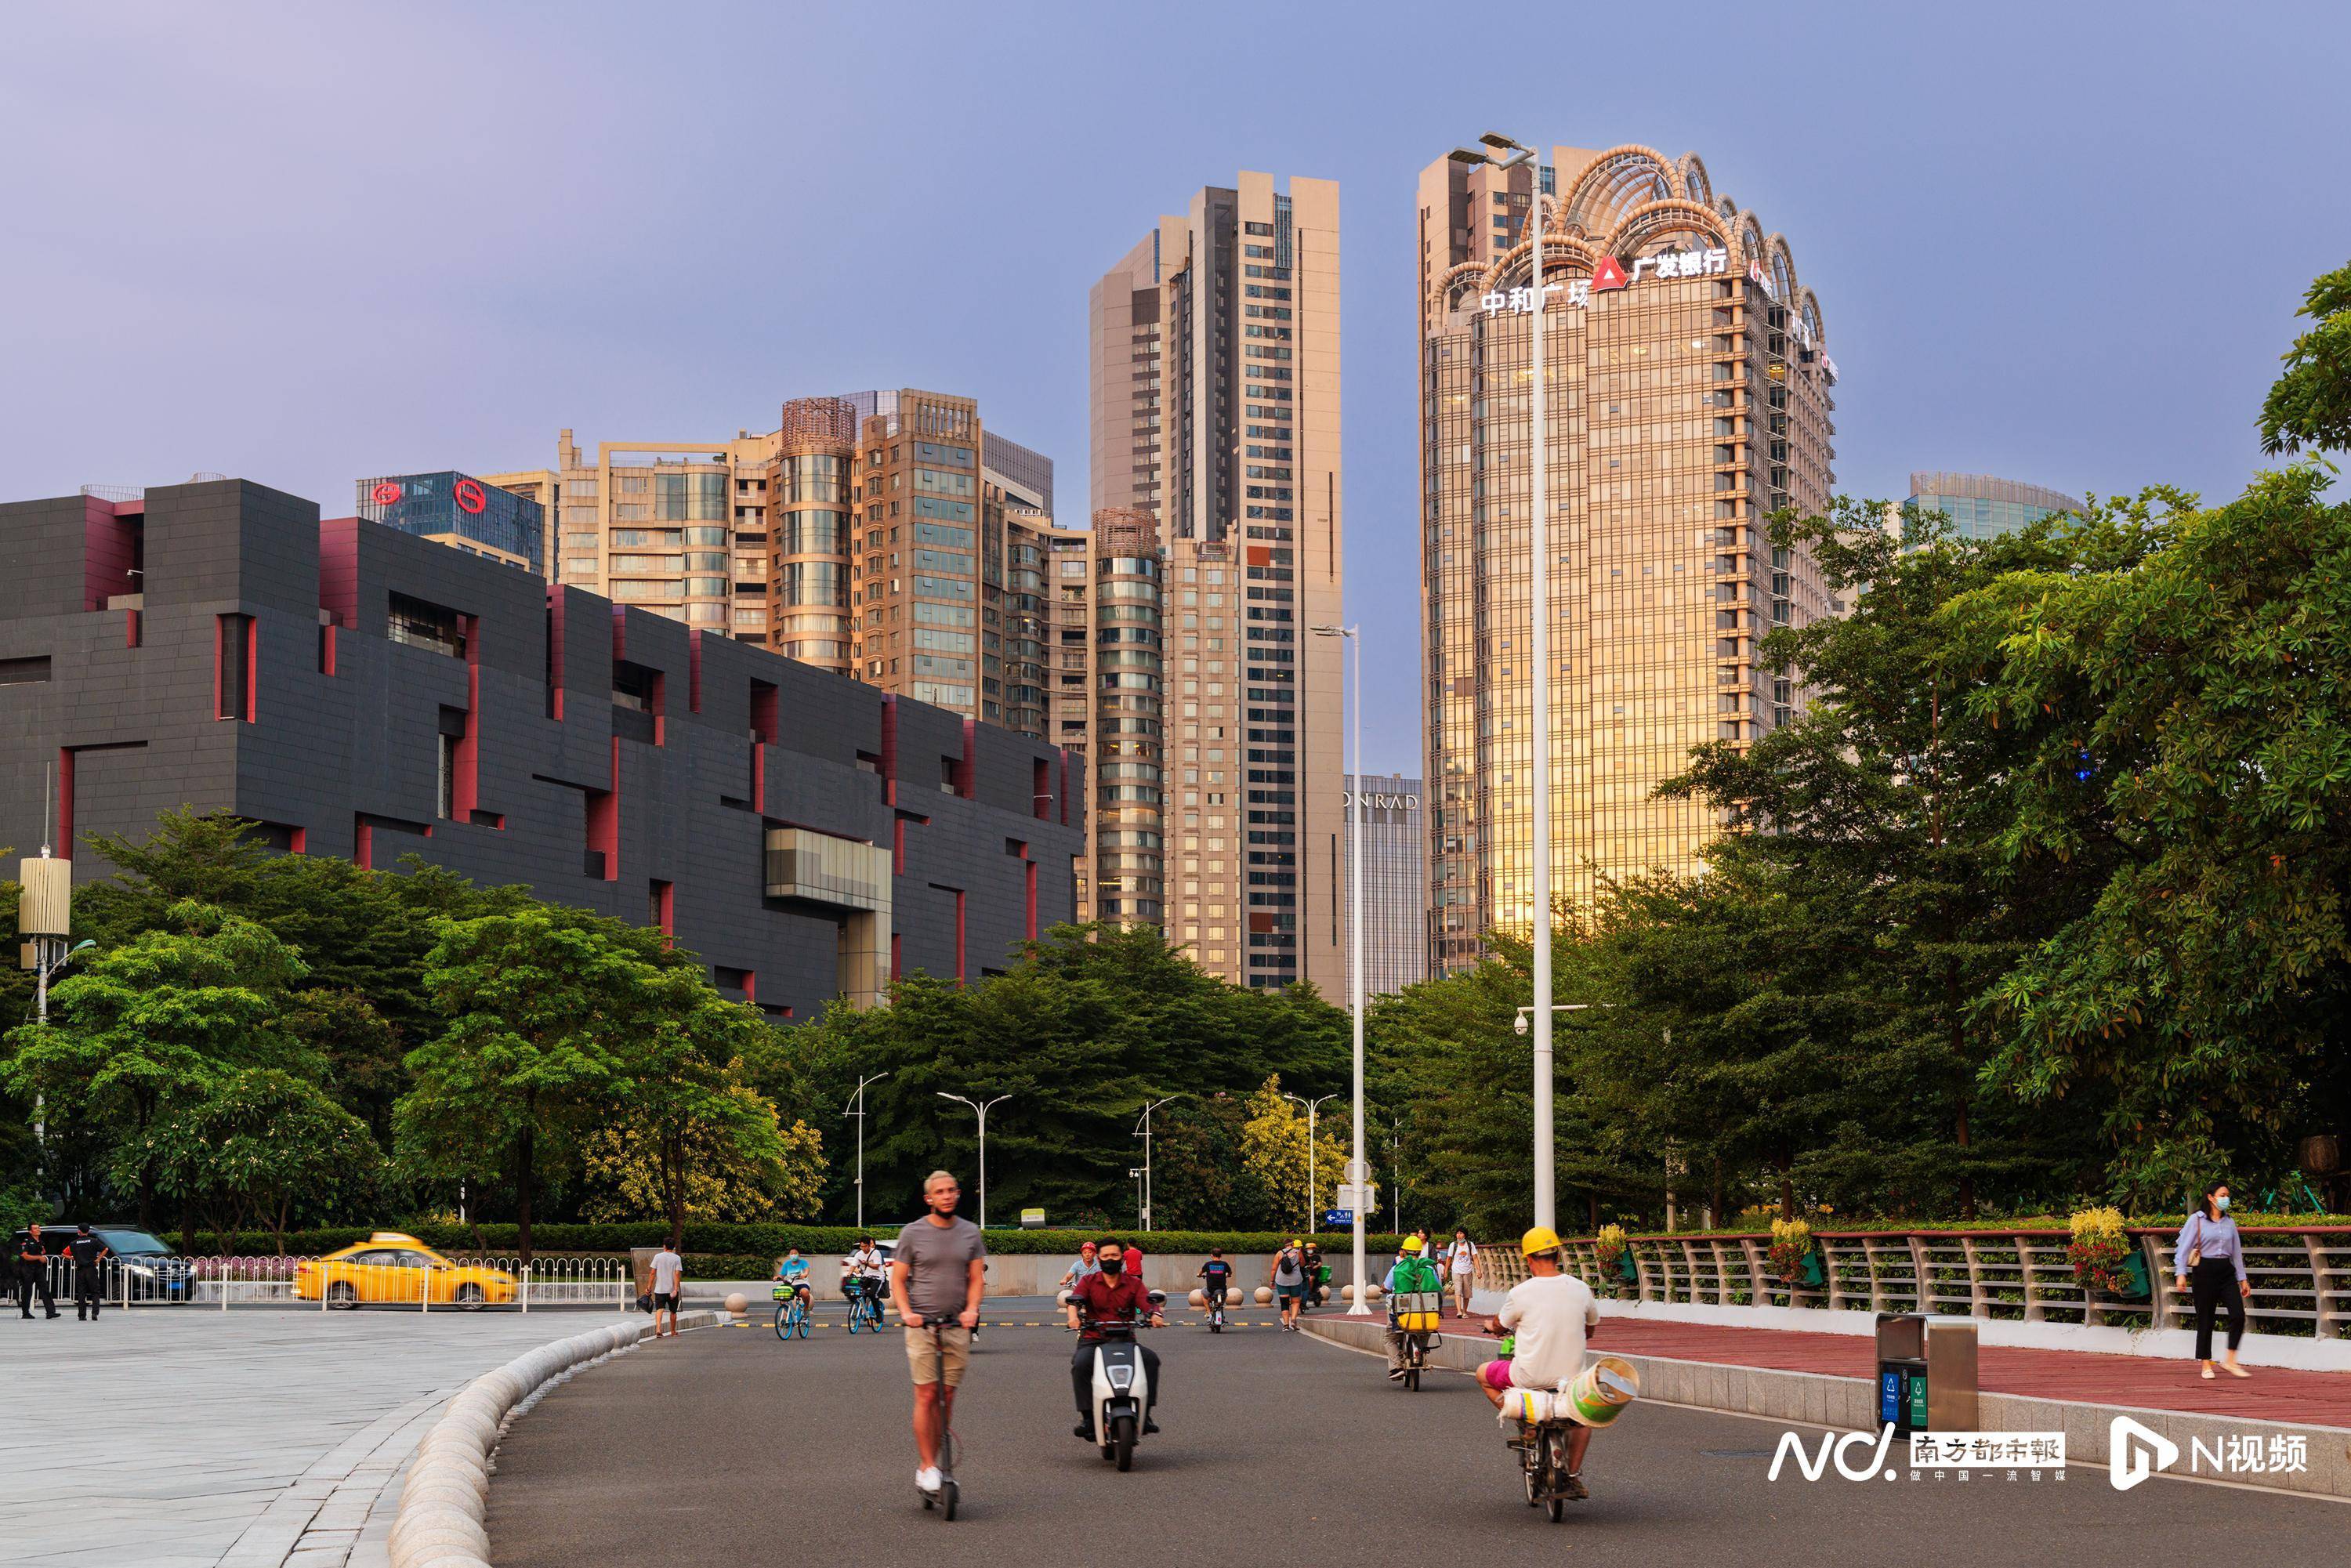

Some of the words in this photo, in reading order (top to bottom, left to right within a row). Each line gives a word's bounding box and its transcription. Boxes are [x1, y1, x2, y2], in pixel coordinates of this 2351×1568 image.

[1632, 248, 1727, 281] 广发银行
[1481, 279, 1592, 317] 中和广场
